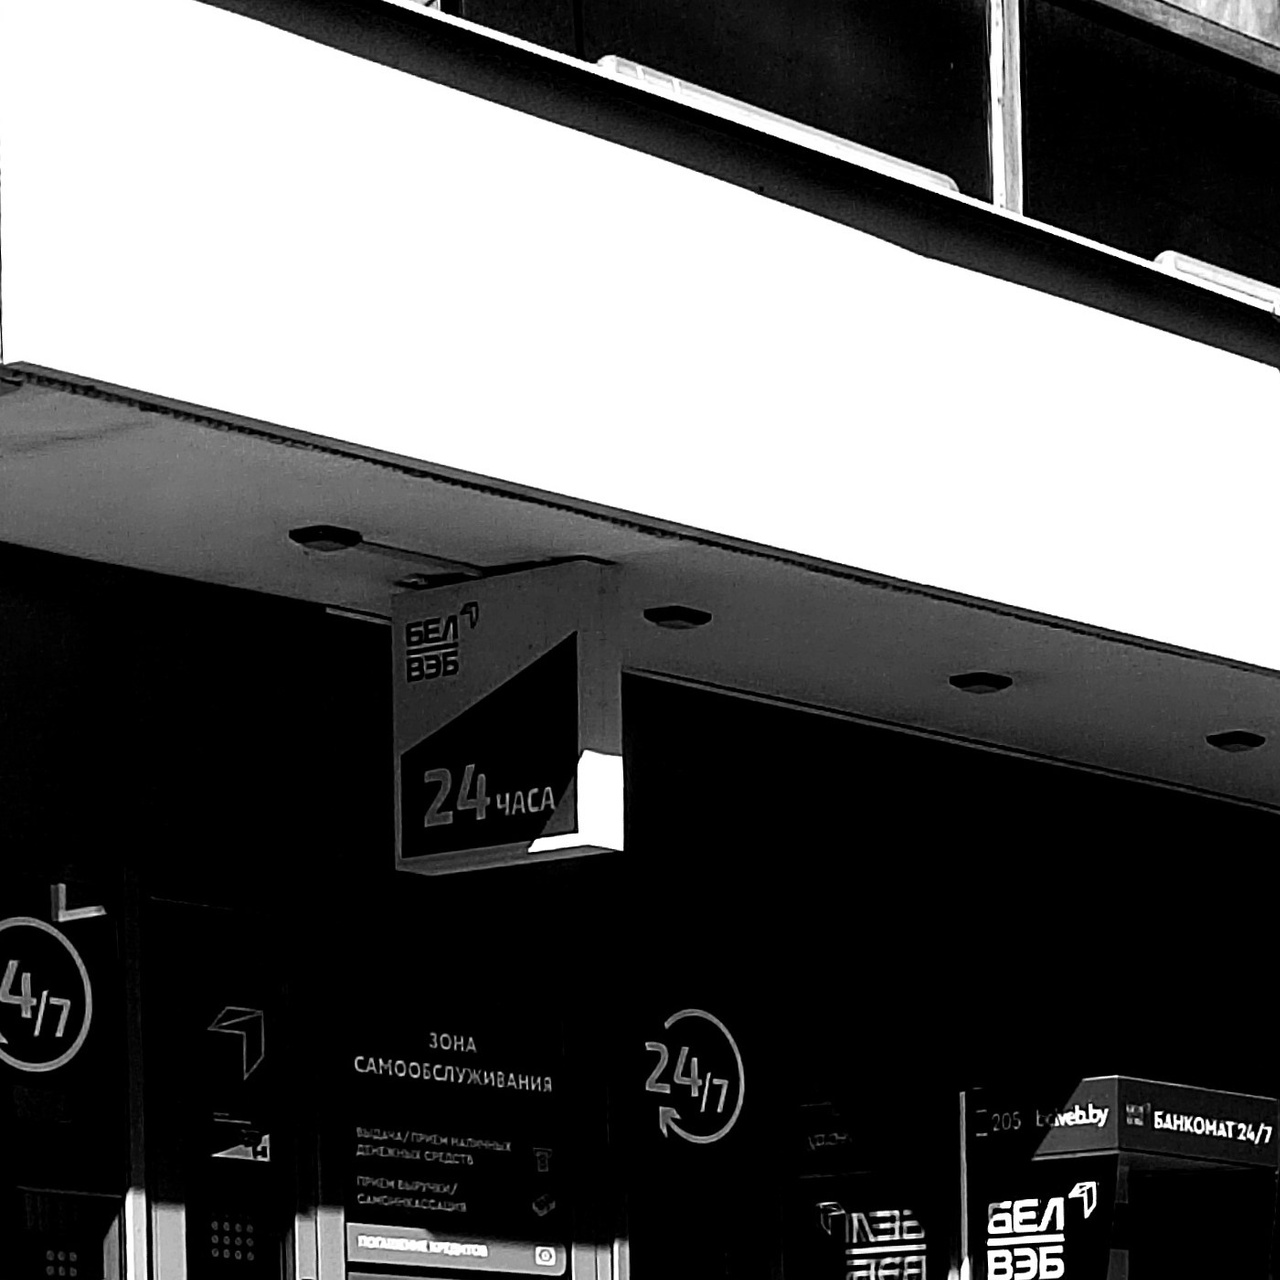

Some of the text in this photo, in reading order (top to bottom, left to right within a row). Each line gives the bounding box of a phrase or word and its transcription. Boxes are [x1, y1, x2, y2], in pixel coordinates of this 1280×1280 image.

[406, 615, 458, 646] БЕЛ
[406, 651, 459, 682] ВЭБ
[424, 764, 556, 828] 24 ЧАСА
[429, 1031, 477, 1053] ЗОНА
[354, 1055, 553, 1092] САМООБСЛУЖИВАНИЯ
[645, 1041, 729, 1113] 24/7
[991, 1110, 1022, 1132] 205
[1154, 1110, 1235, 1139] БАНКОМАТ
[1237, 1121, 1274, 1145] 24/7
[987, 1196, 1066, 1235] БЕЛ
